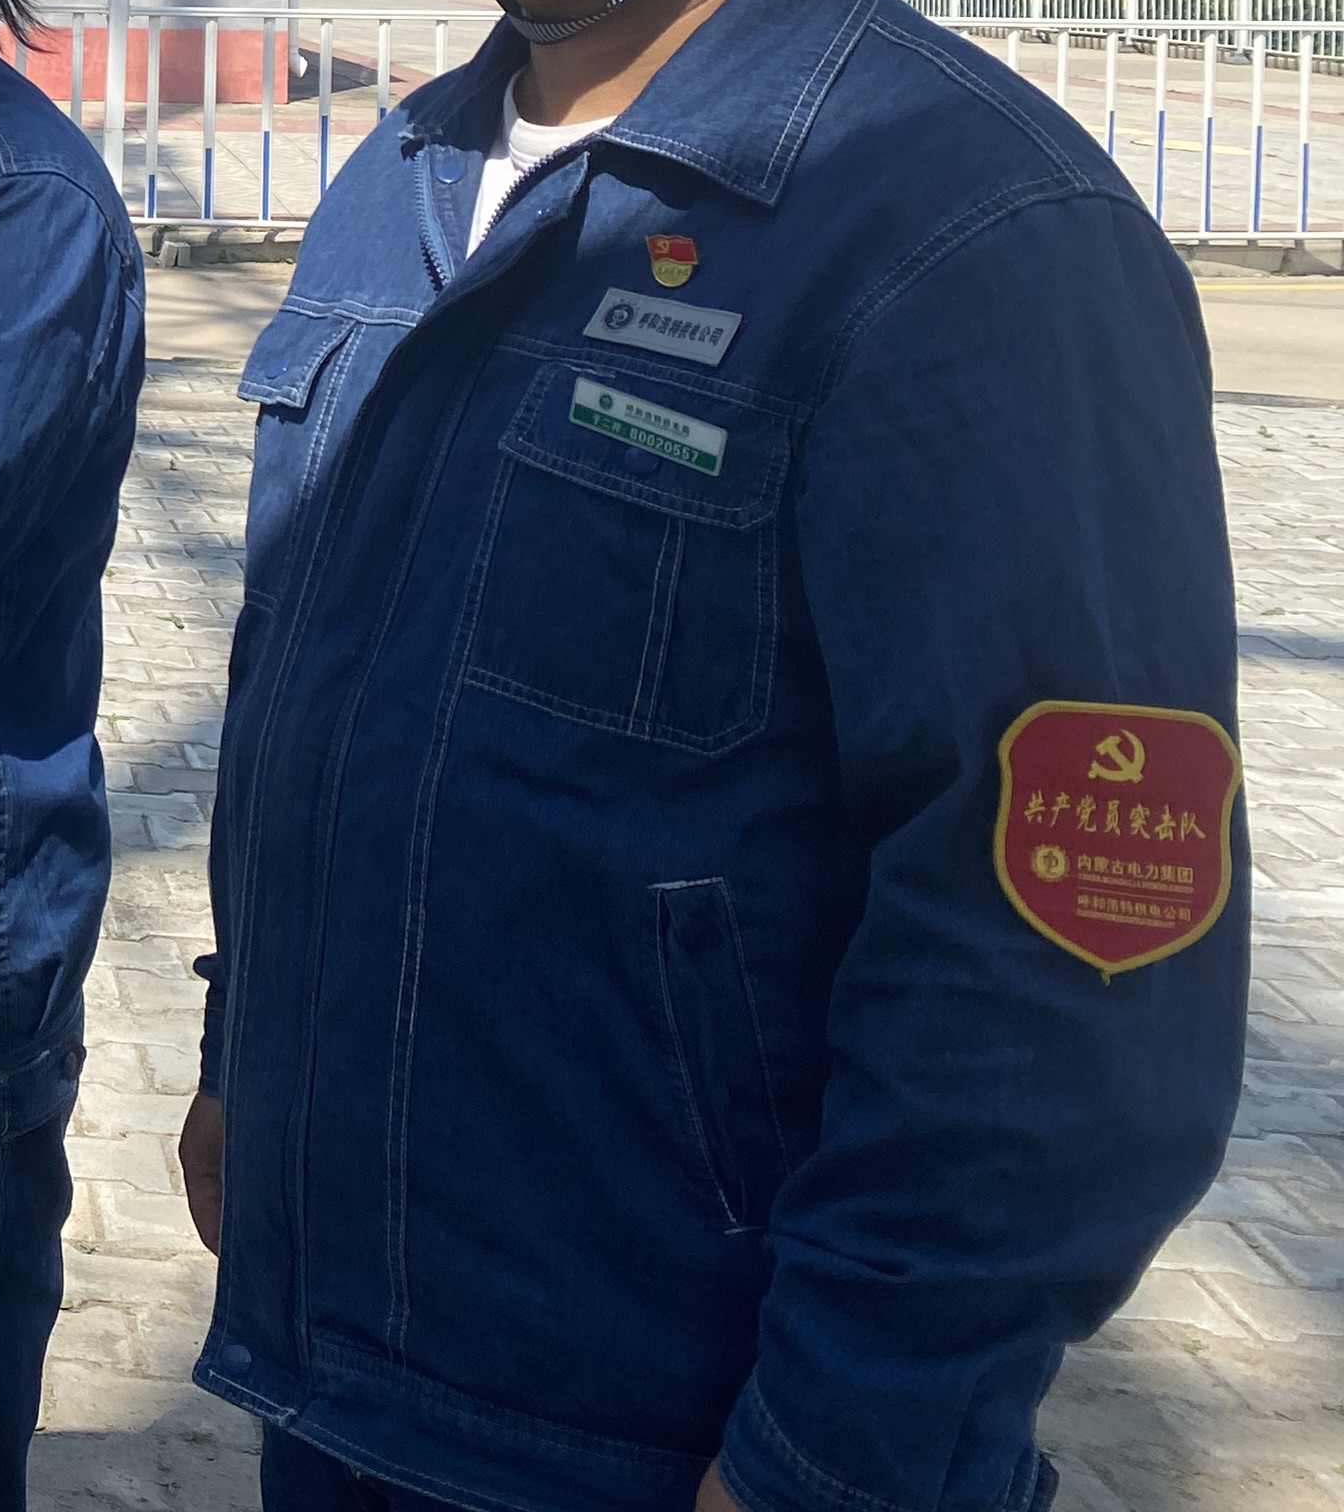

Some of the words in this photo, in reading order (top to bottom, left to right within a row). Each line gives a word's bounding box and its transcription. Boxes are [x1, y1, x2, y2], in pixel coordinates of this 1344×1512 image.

[1024, 790, 1206, 841] 共产党员突击队
[1077, 854, 1194, 883] 内蒙古电力集团
